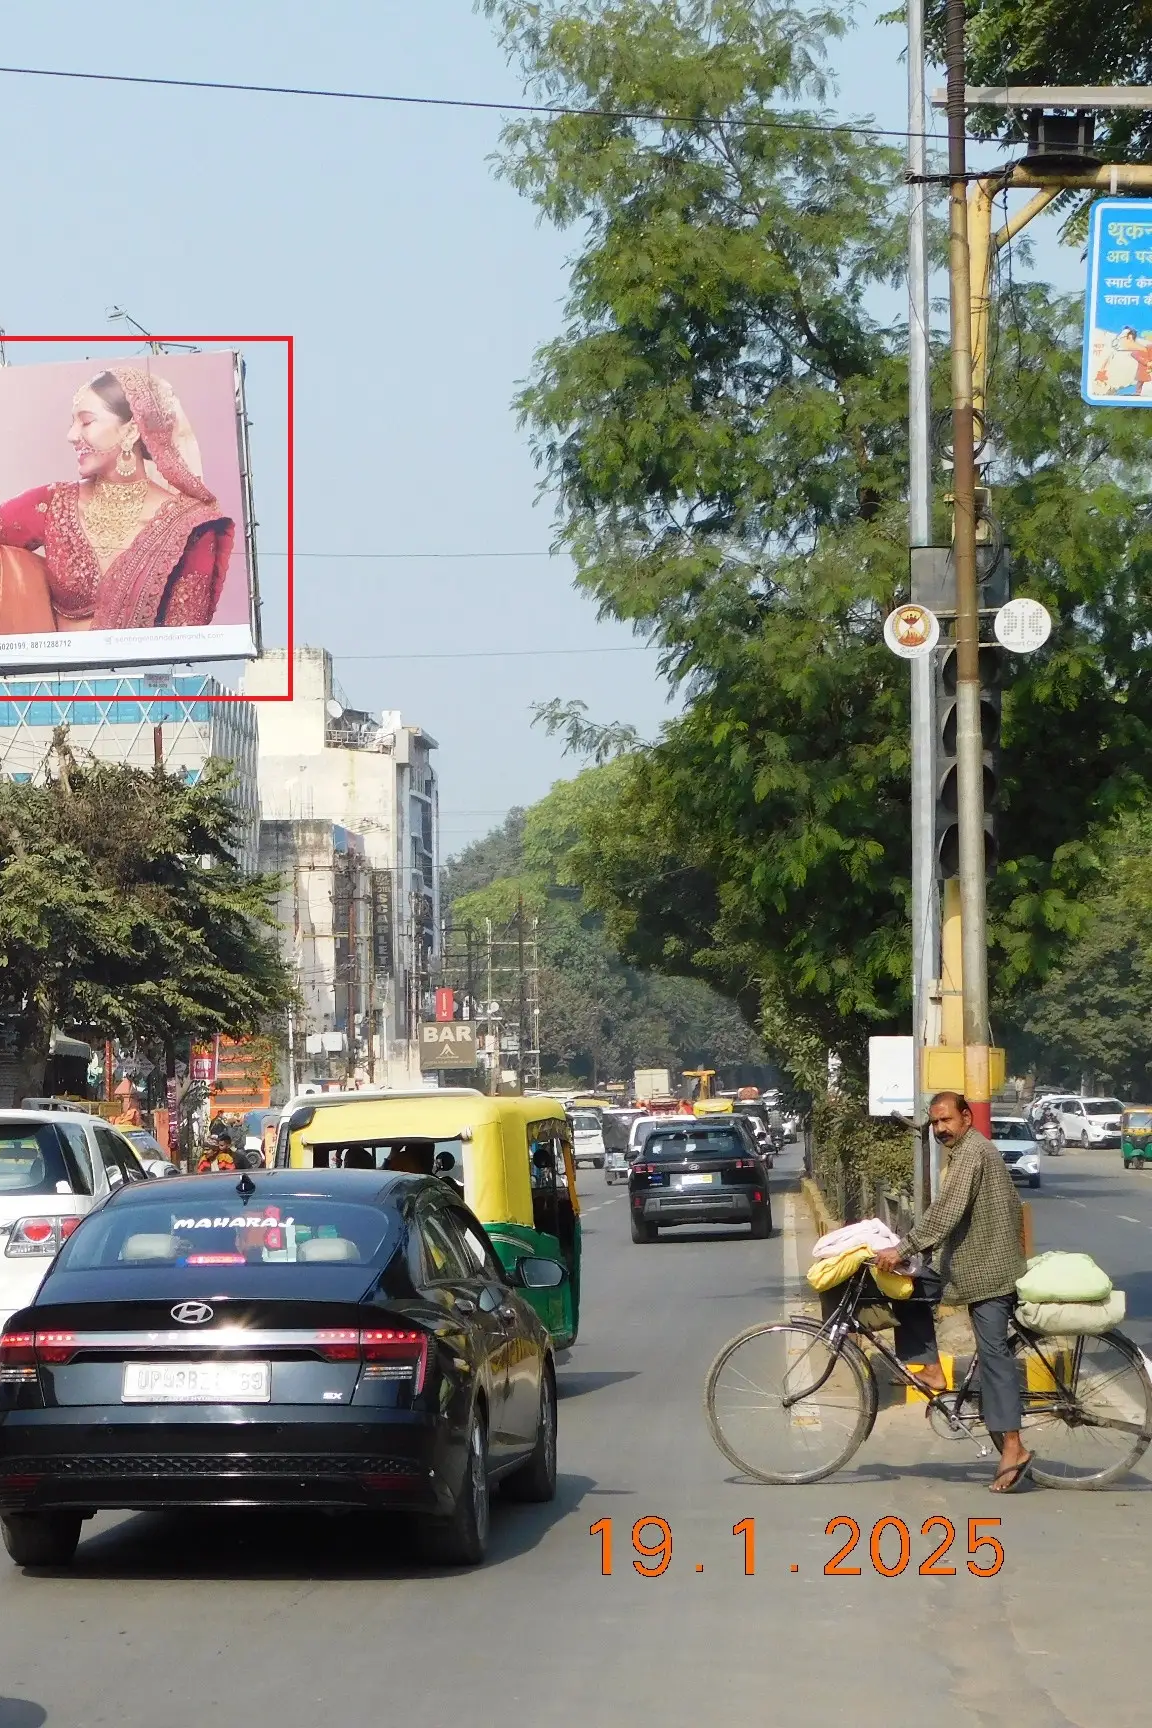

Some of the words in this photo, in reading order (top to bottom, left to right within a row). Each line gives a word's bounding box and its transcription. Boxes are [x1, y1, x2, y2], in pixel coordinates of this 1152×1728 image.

[1106, 250, 1130, 263] अब
[1104, 274, 1133, 289] स्मार्ट
[1104, 294, 1140, 306] चालान
[423, 1025, 473, 1043] BAR
[173, 1217, 295, 1229] MAHARAJ
